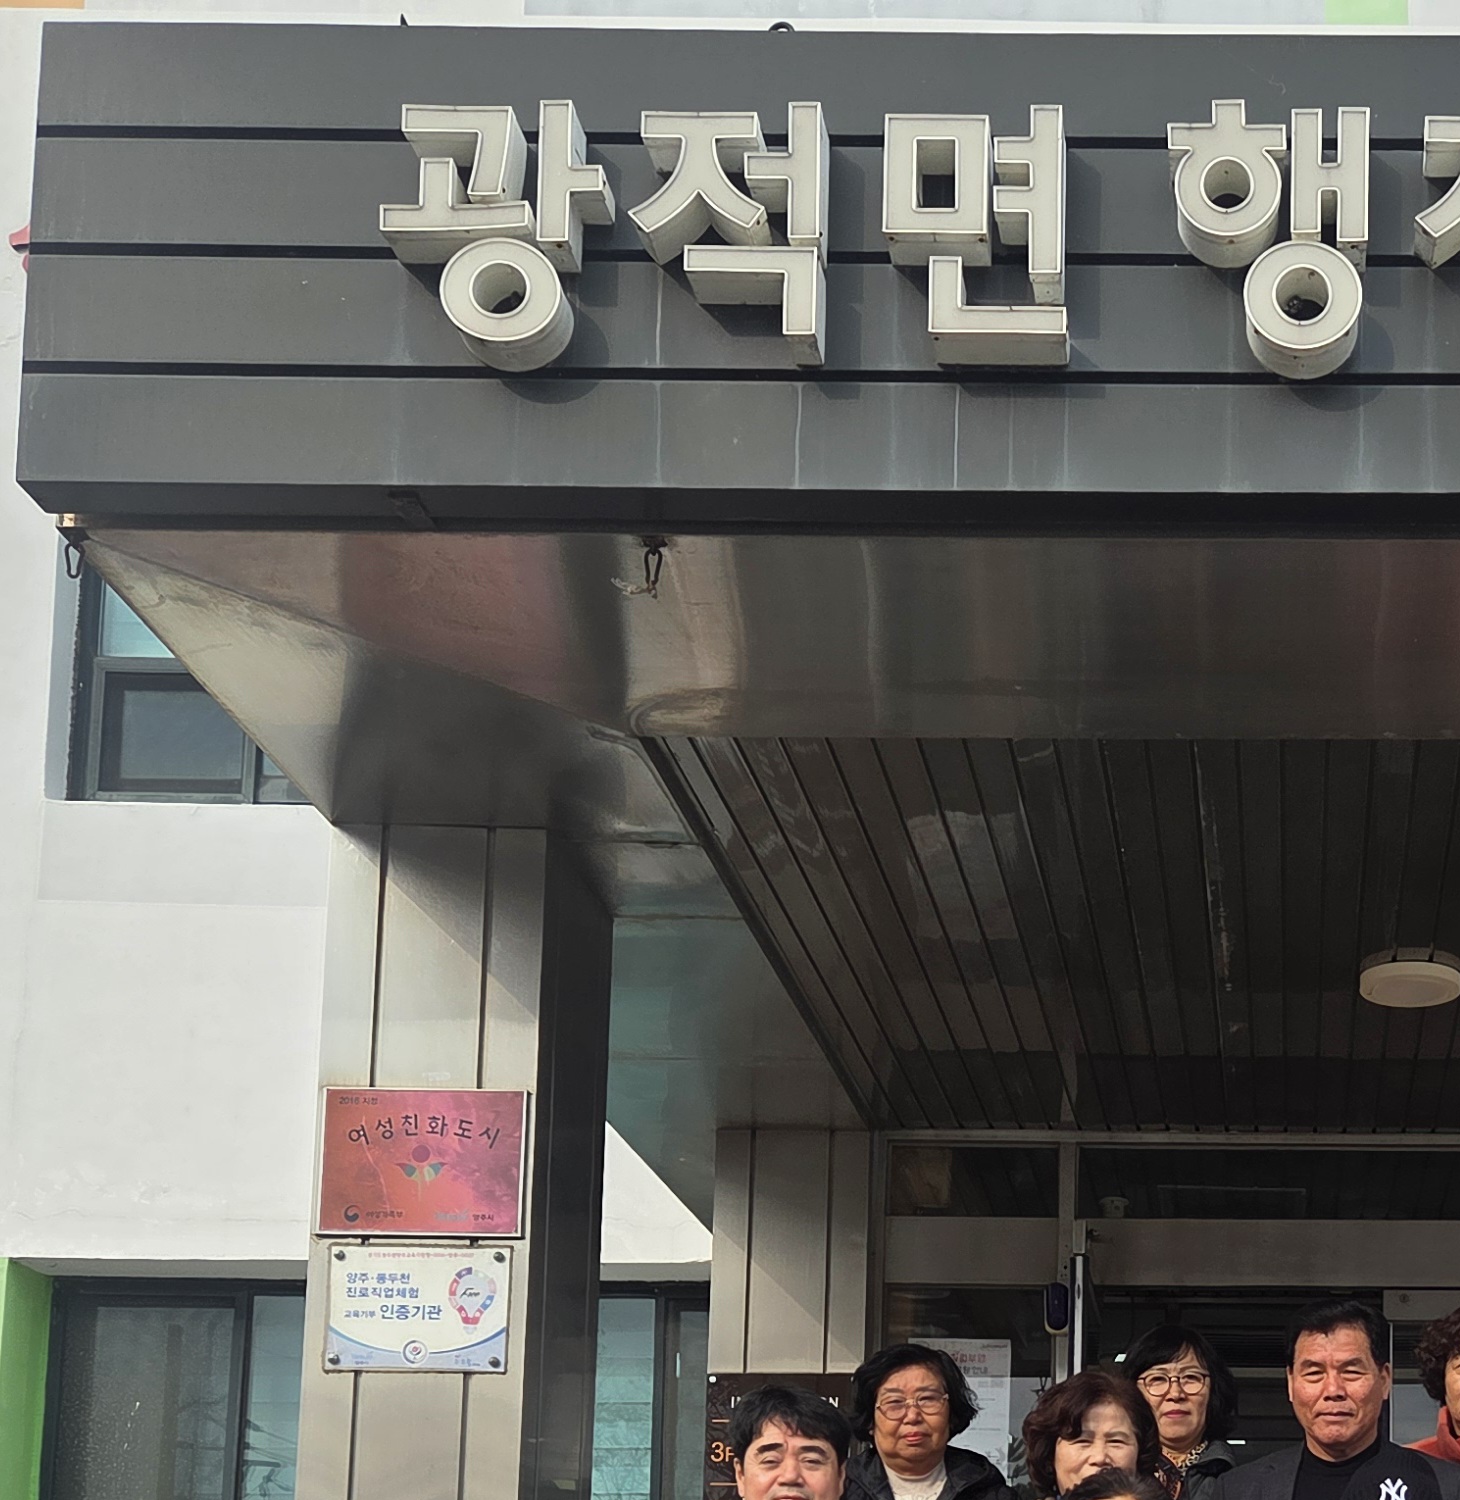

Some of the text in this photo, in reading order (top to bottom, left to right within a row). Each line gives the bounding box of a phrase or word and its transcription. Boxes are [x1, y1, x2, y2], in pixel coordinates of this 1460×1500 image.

[379, 100, 1070, 371] 광적면
[348, 1113, 500, 1149] 여성친화도시
[380, 1304, 443, 1320] 인증기관
[710, 1441, 735, 1462] 3F
